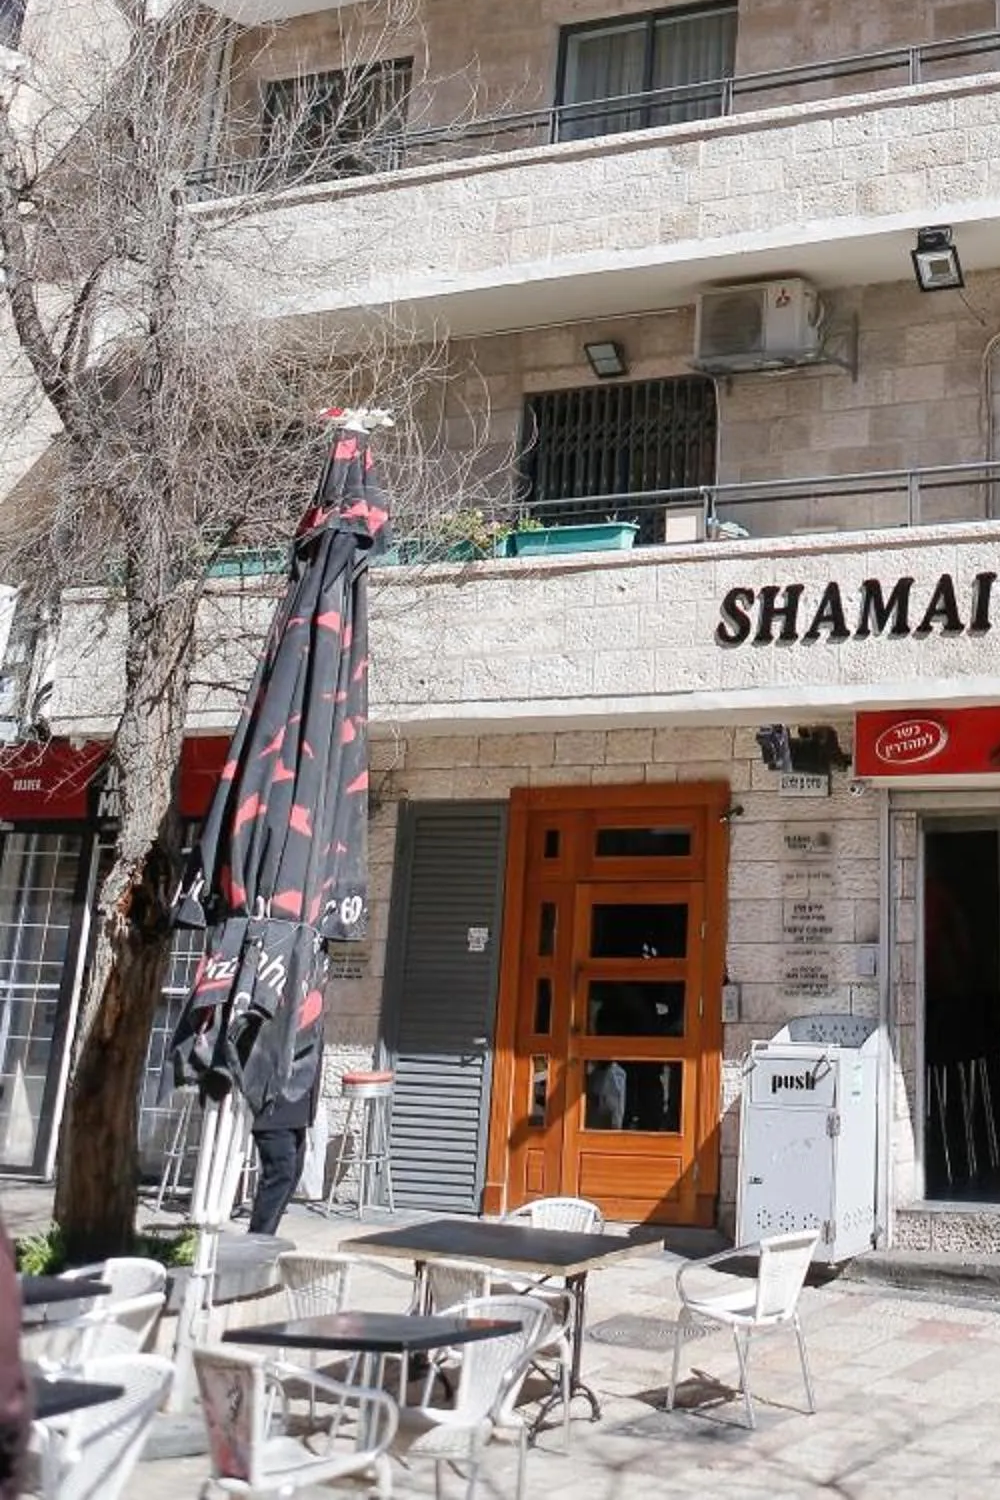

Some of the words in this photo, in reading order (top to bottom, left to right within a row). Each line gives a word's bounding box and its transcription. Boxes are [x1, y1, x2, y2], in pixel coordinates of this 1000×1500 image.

[715, 571, 998, 648] SHAMAI
[894, 724, 921, 738] כשר
[884, 732, 934, 758] למהדרין
[771, 1071, 816, 1095] push
